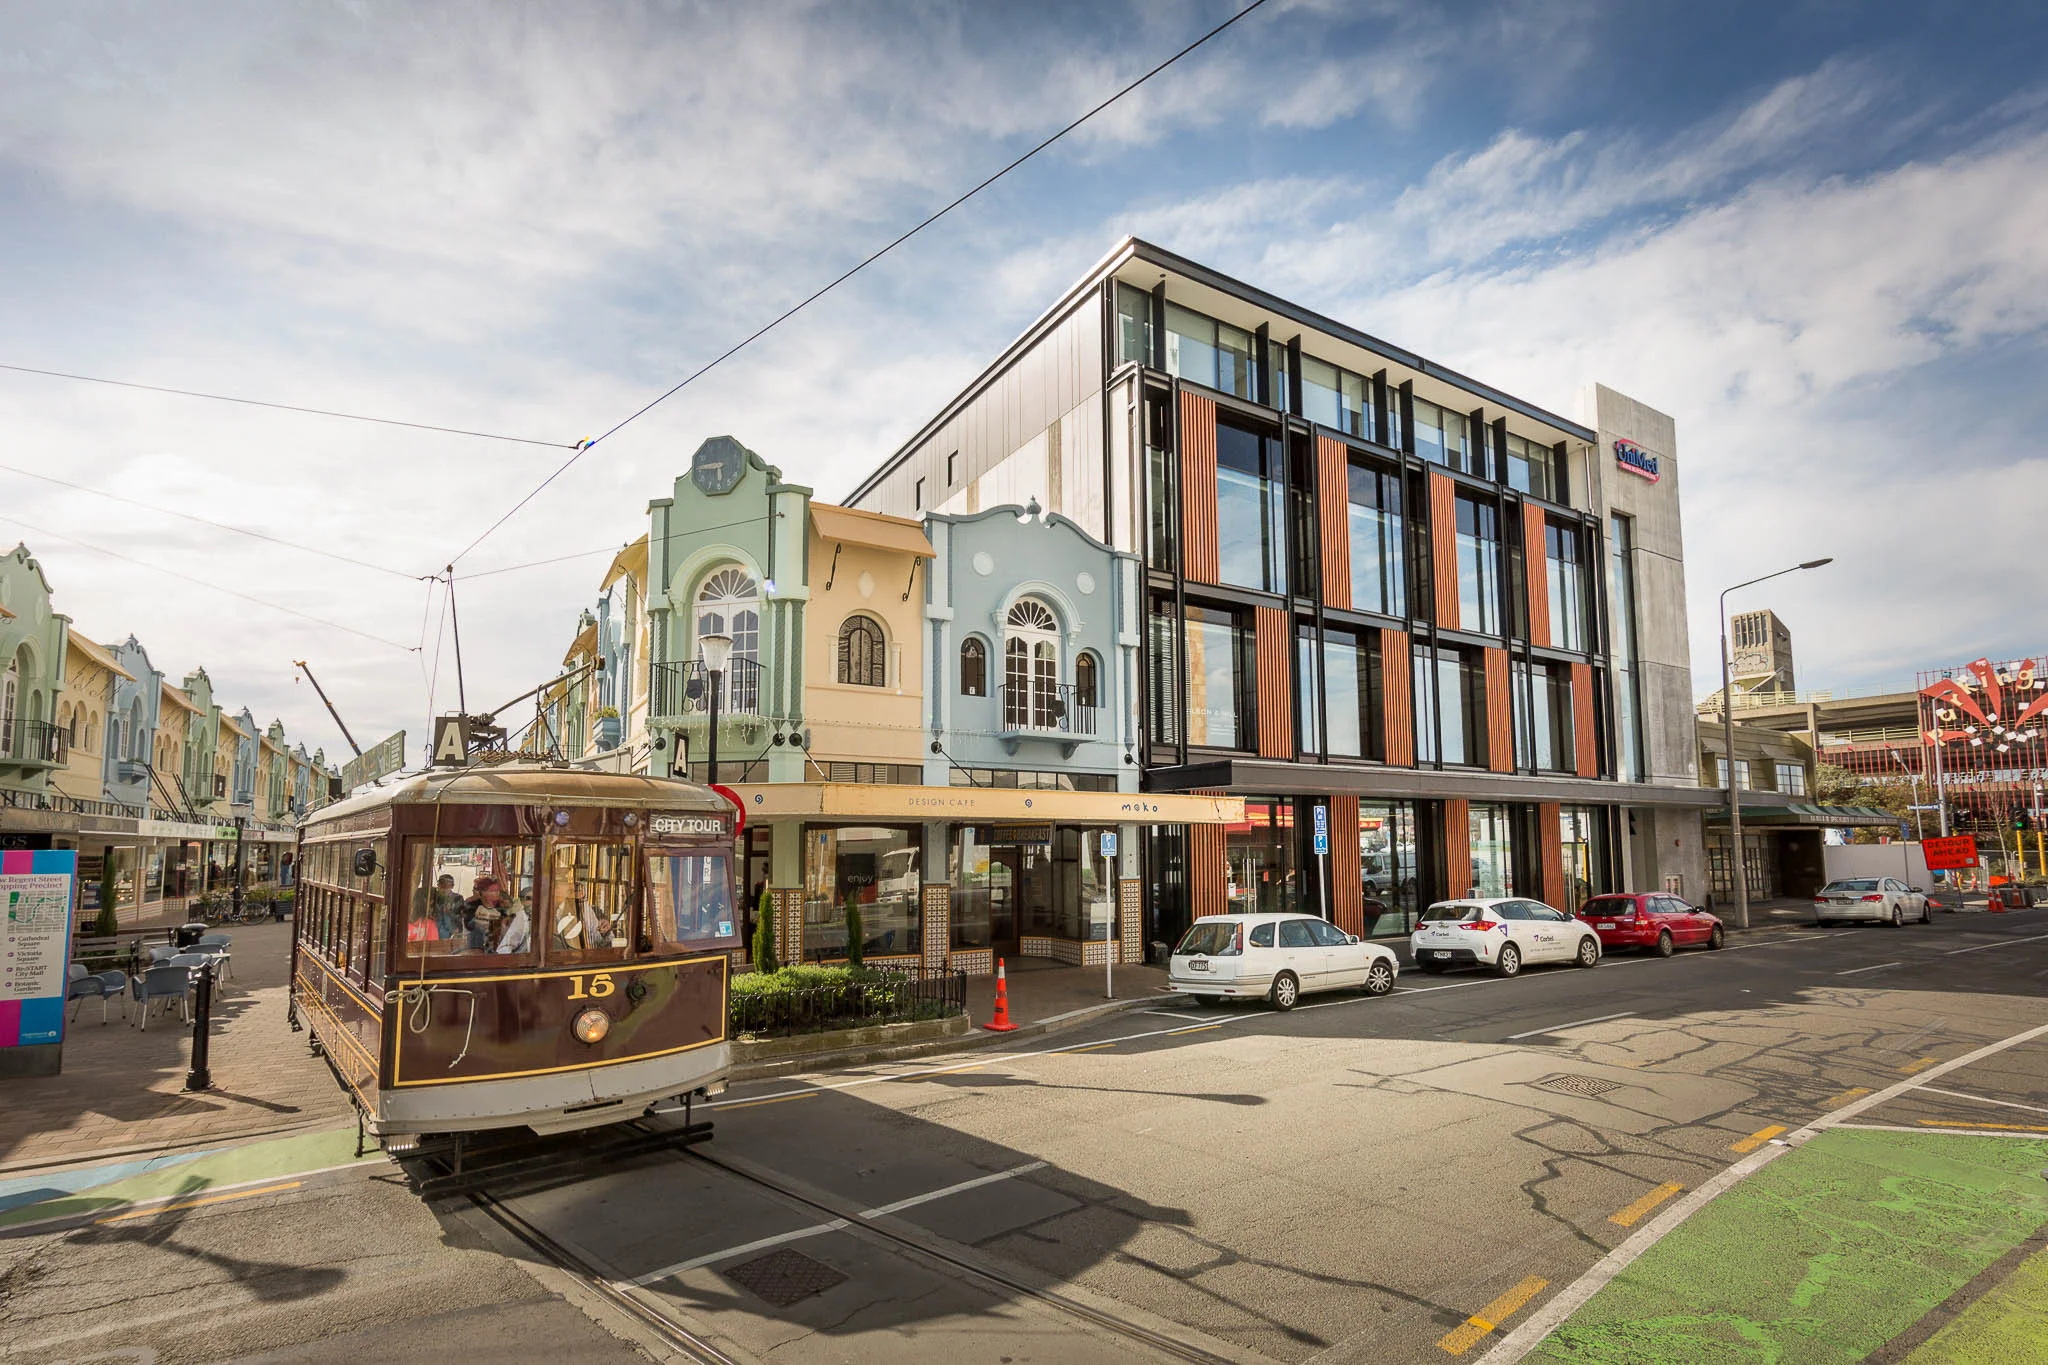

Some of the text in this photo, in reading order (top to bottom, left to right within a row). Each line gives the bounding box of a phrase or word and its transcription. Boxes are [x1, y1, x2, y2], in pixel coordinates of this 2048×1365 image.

[435, 722, 465, 761] A
[674, 738, 687, 773] A
[908, 798, 945, 806] DESIGN
[655, 818, 721, 834] CITY TOUR
[1928, 838, 1970, 849] DETOUR
[1933, 848, 1969, 857] AHEAD
[847, 874, 874, 884] enjoy
[567, 973, 616, 1000] 15
